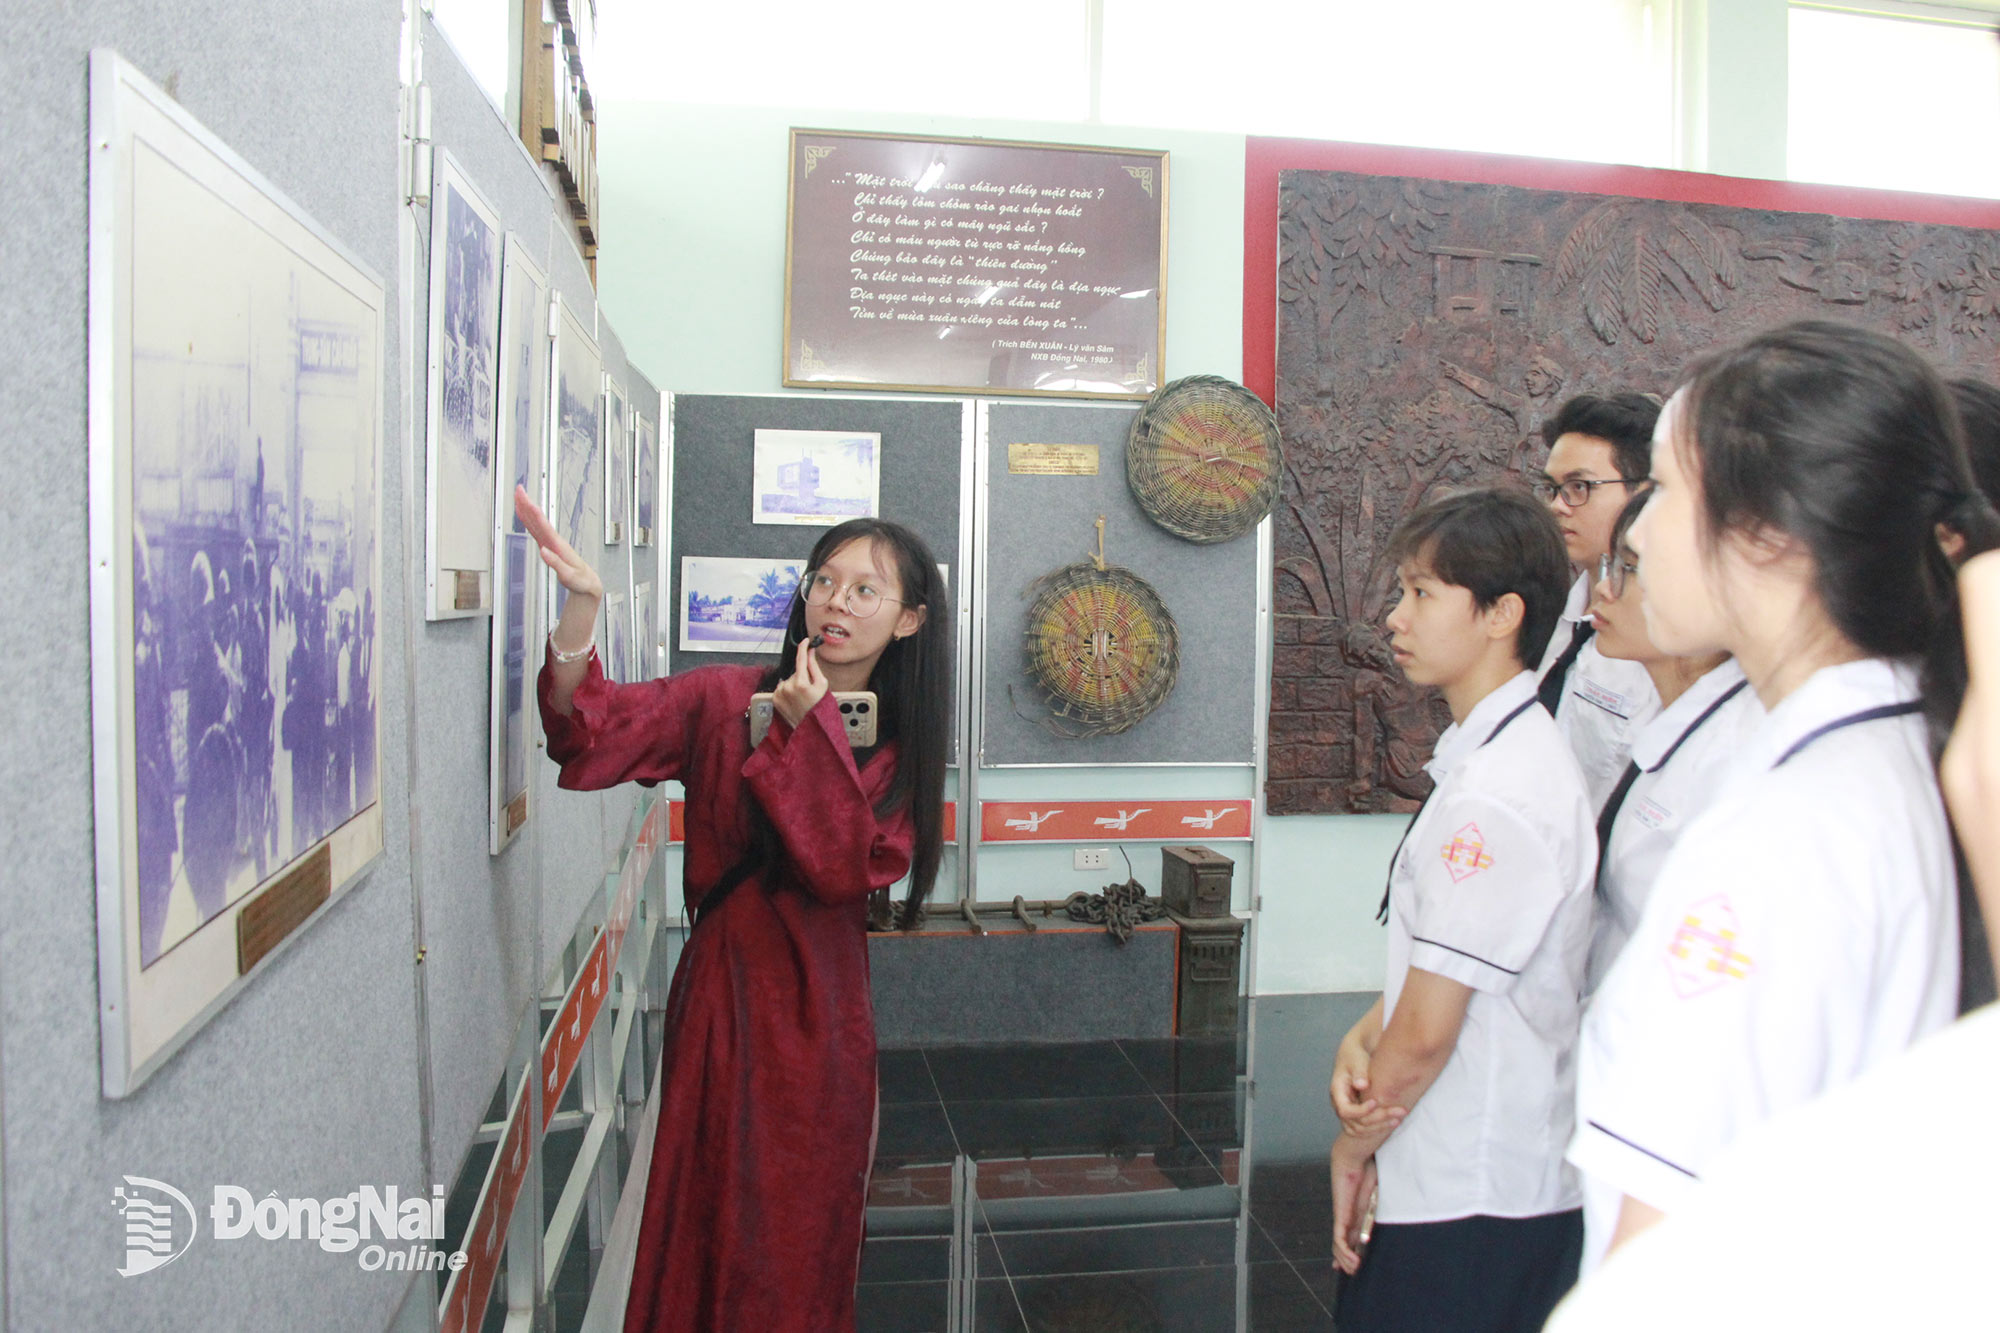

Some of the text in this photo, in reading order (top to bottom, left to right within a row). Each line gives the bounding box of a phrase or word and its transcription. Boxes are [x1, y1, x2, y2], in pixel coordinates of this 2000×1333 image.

[855, 172, 886, 189] Mặt
[889, 176, 913, 187] trời
[945, 182, 966, 191] sao
[1009, 183, 1037, 198] thấy
[1041, 187, 1066, 199] mặt
[1069, 188, 1093, 199] trời
[1097, 188, 1105, 200] ?
[854, 191, 876, 207] Chỉ
[878, 194, 908, 209] thấy
[974, 201, 995, 211] rào
[999, 203, 1019, 215] gai
[1023, 202, 1051, 216] nhọn
[1055, 204, 1083, 217] hoắt
[851, 206, 1048, 234] Ở đây làm gì có mây ngũ sắc ?
[850, 229, 1087, 258] Chỉ có máu người tù rực rỡ nắng hồng
[850, 249, 892, 265] Chúng
[895, 251, 918, 264] bảo
[921, 254, 947, 268] đây
[950, 256, 964, 266] là
[850, 268, 869, 281] Ta
[872, 269, 898, 282] thét
[901, 272, 923, 283] vào
[927, 274, 952, 287] mặt
[956, 274, 993, 288] chúng
[1023, 278, 1047, 291] đây
[1051, 279, 1065, 291] là
[1068, 281, 1090, 294] địa
[1093, 286, 1122, 297] ngục
[850, 287, 874, 302] Địa
[878, 293, 908, 304] ngục
[911, 292, 935, 305] này
[939, 293, 953, 303] có
[990, 296, 1004, 306] ta
[1039, 298, 1062, 309] nát
[849, 306, 876, 319] Tìm
[879, 308, 895, 320] về
[897, 310, 925, 322] mùa
[928, 312, 958, 323] xuân
[960, 313, 993, 328] riêng
[997, 314, 1020, 326] của
[1022, 315, 1050, 331] lòng
[1053, 320, 1067, 329] ta
[1019, 339, 1038, 349] BẾN
[1030, 353, 1049, 361] NXB
